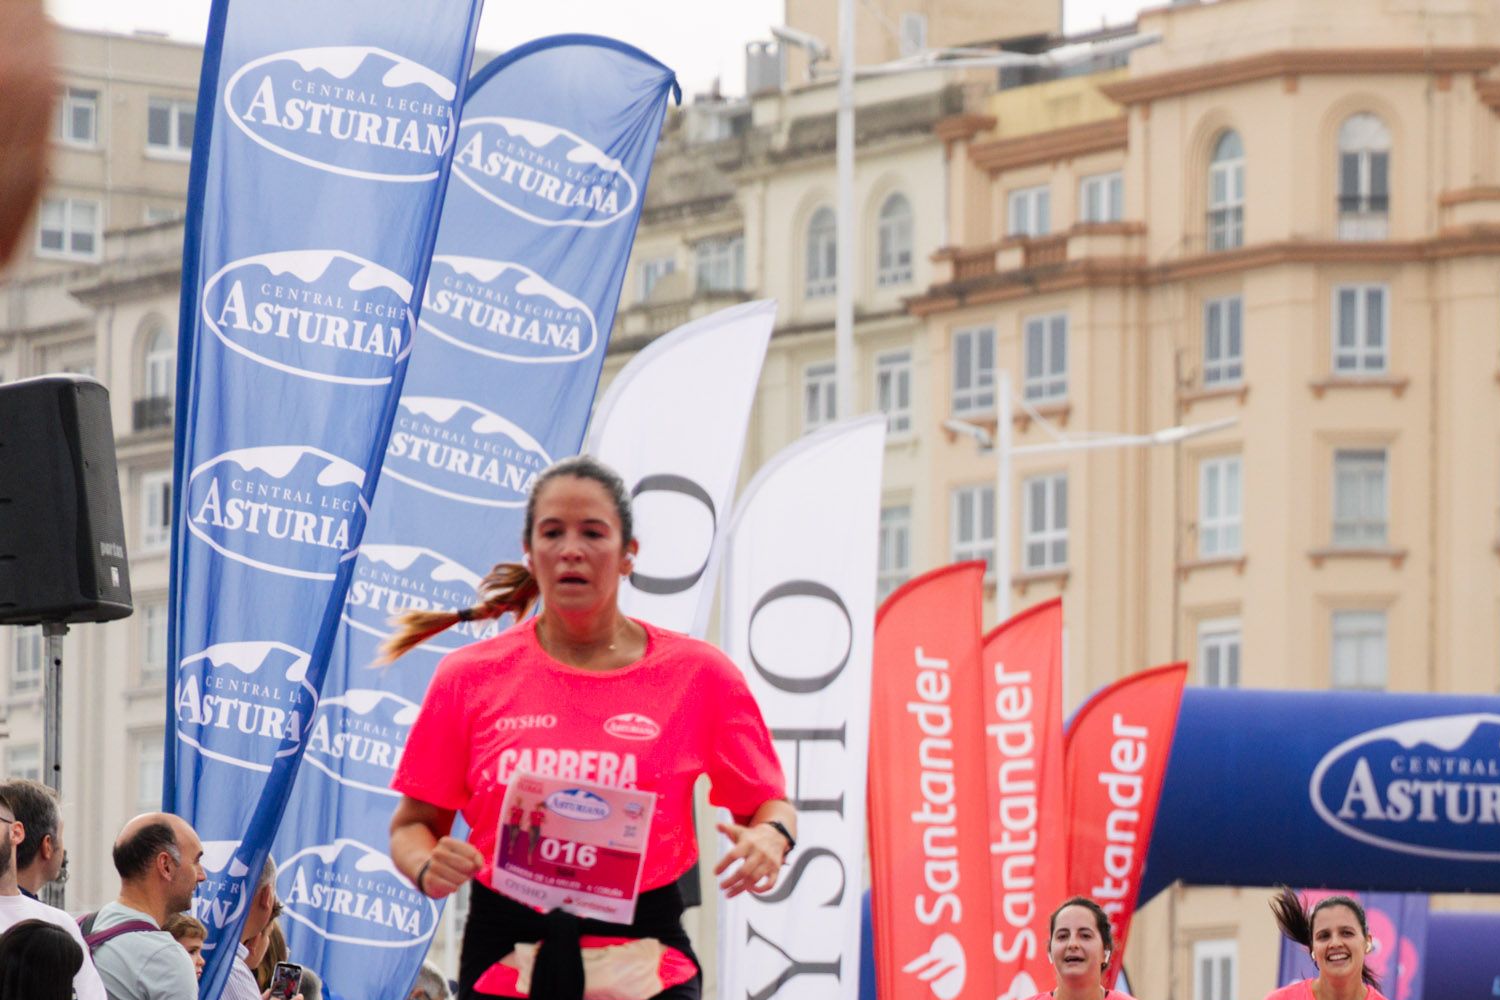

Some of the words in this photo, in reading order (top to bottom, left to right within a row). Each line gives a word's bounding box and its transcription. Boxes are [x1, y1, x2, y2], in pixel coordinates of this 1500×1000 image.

[292, 78, 377, 106] CENTRAL
[496, 137, 561, 172] CENTRAL
[454, 131, 619, 214] ASTURIANA
[261, 283, 343, 310] CENTRAL
[443, 275, 511, 308] CENTRAL
[515, 299, 582, 324] LECHERA
[399, 417, 467, 445] CENTRAL
[473, 438, 540, 468] LECHERA
[387, 431, 538, 495] STURIANA
[231, 478, 313, 506] CENTRAL
[359, 565, 426, 592] CENTRAL
[205, 674, 282, 700] CENTRAL
[494, 713, 558, 731] OYSHO
[497, 747, 638, 790] CARRERA
[1391, 755, 1499, 776] CENTRAL
[906, 646, 963, 926] Santander
[985, 661, 1038, 963] Santander
[1091, 713, 1149, 930] ntander
[539, 838, 598, 868] 016
